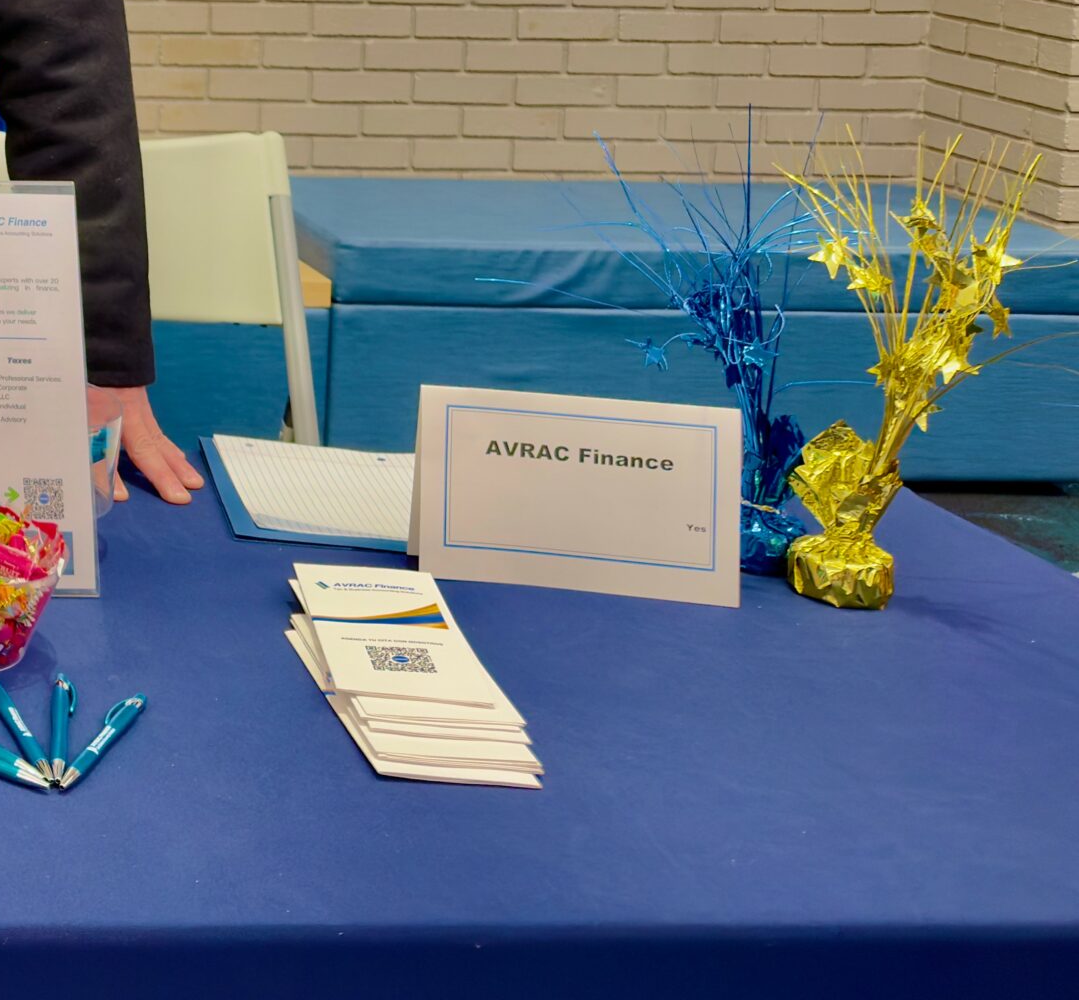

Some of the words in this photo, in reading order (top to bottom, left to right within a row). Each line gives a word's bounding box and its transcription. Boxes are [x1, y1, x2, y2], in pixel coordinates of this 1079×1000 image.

[8, 218, 47, 226] Finance
[486, 440, 569, 461] AVRAC
[579, 448, 674, 471] Finance
[687, 524, 706, 533] Yes
